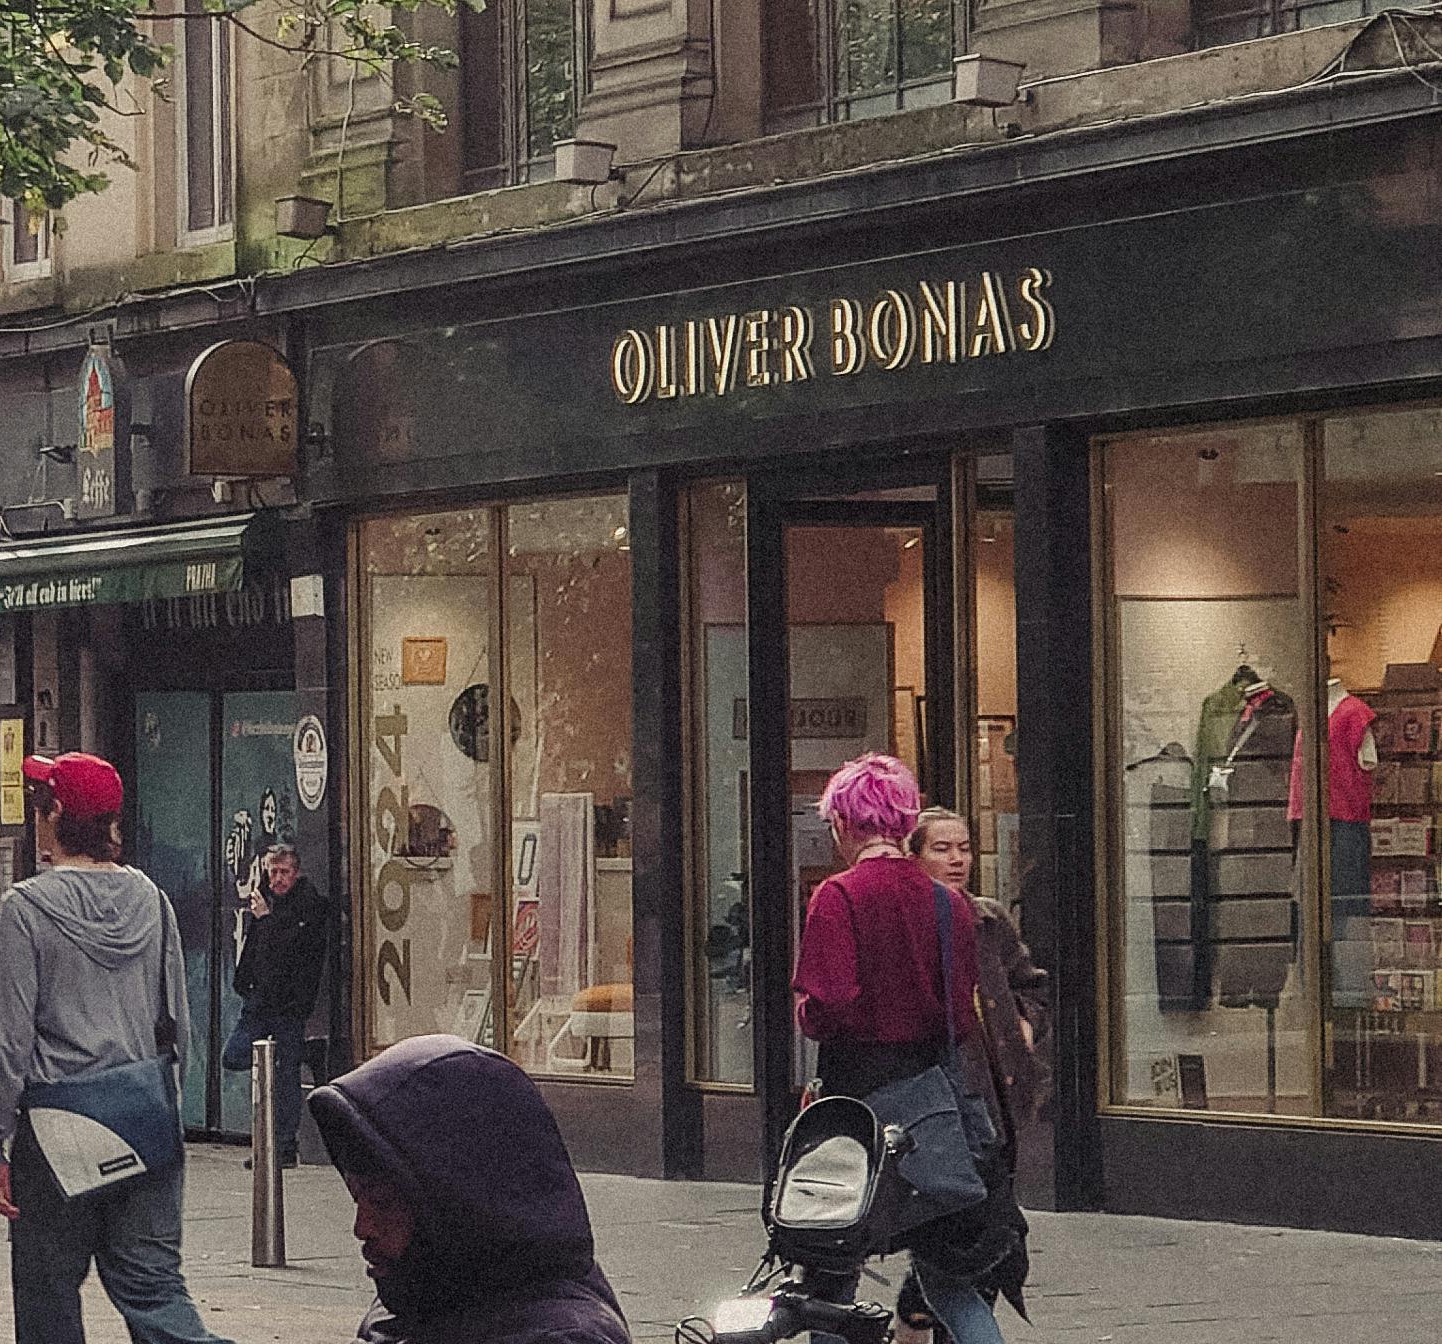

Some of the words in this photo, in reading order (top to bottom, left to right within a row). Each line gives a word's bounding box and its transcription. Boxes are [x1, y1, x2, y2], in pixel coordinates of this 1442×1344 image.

[611, 306, 815, 405] OLIVER
[831, 267, 1056, 376] BONAS
[199, 400, 292, 419] OLIVER
[199, 424, 291, 442] BONAS
